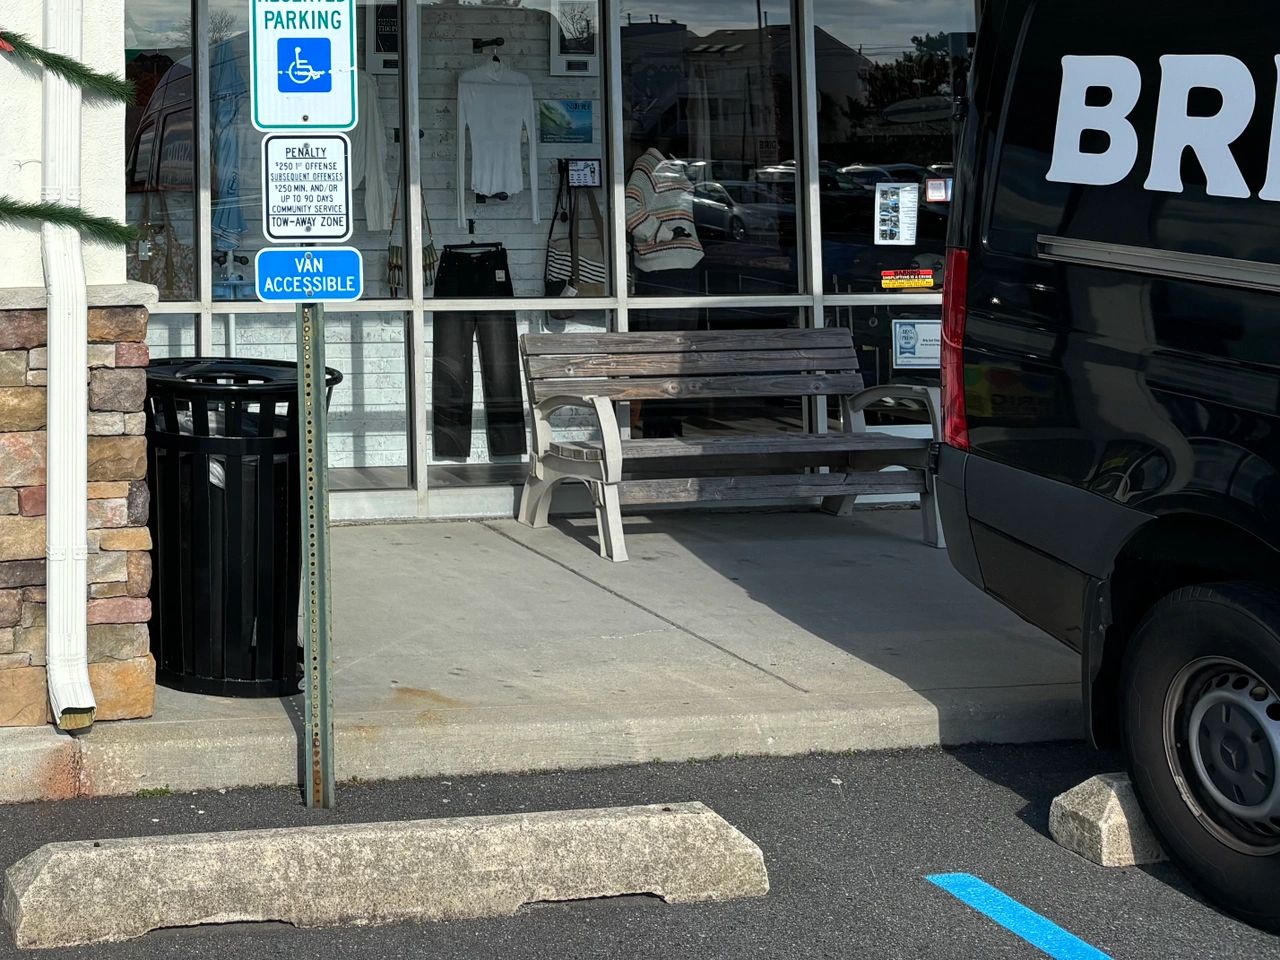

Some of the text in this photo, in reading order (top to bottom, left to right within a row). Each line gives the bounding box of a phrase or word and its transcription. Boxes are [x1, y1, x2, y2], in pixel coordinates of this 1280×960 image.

[264, 10, 342, 30] PARKING
[285, 147, 327, 158] PENALTY
[275, 162, 293, 171] $250
[305, 162, 338, 170] OFFENSE
[270, 172, 343, 181] SUBSEQUENT OFFENSES
[275, 183, 338, 193] $250 MIN. AND/OR
[281, 194, 334, 203] UP TO 90 DAYS
[272, 204, 342, 213] COMMUNITY SERVICE
[272, 216, 344, 227] TOW-AWAY ZONE
[294, 257, 324, 273] VAN
[263, 275, 356, 292] ACCESSIBLE
